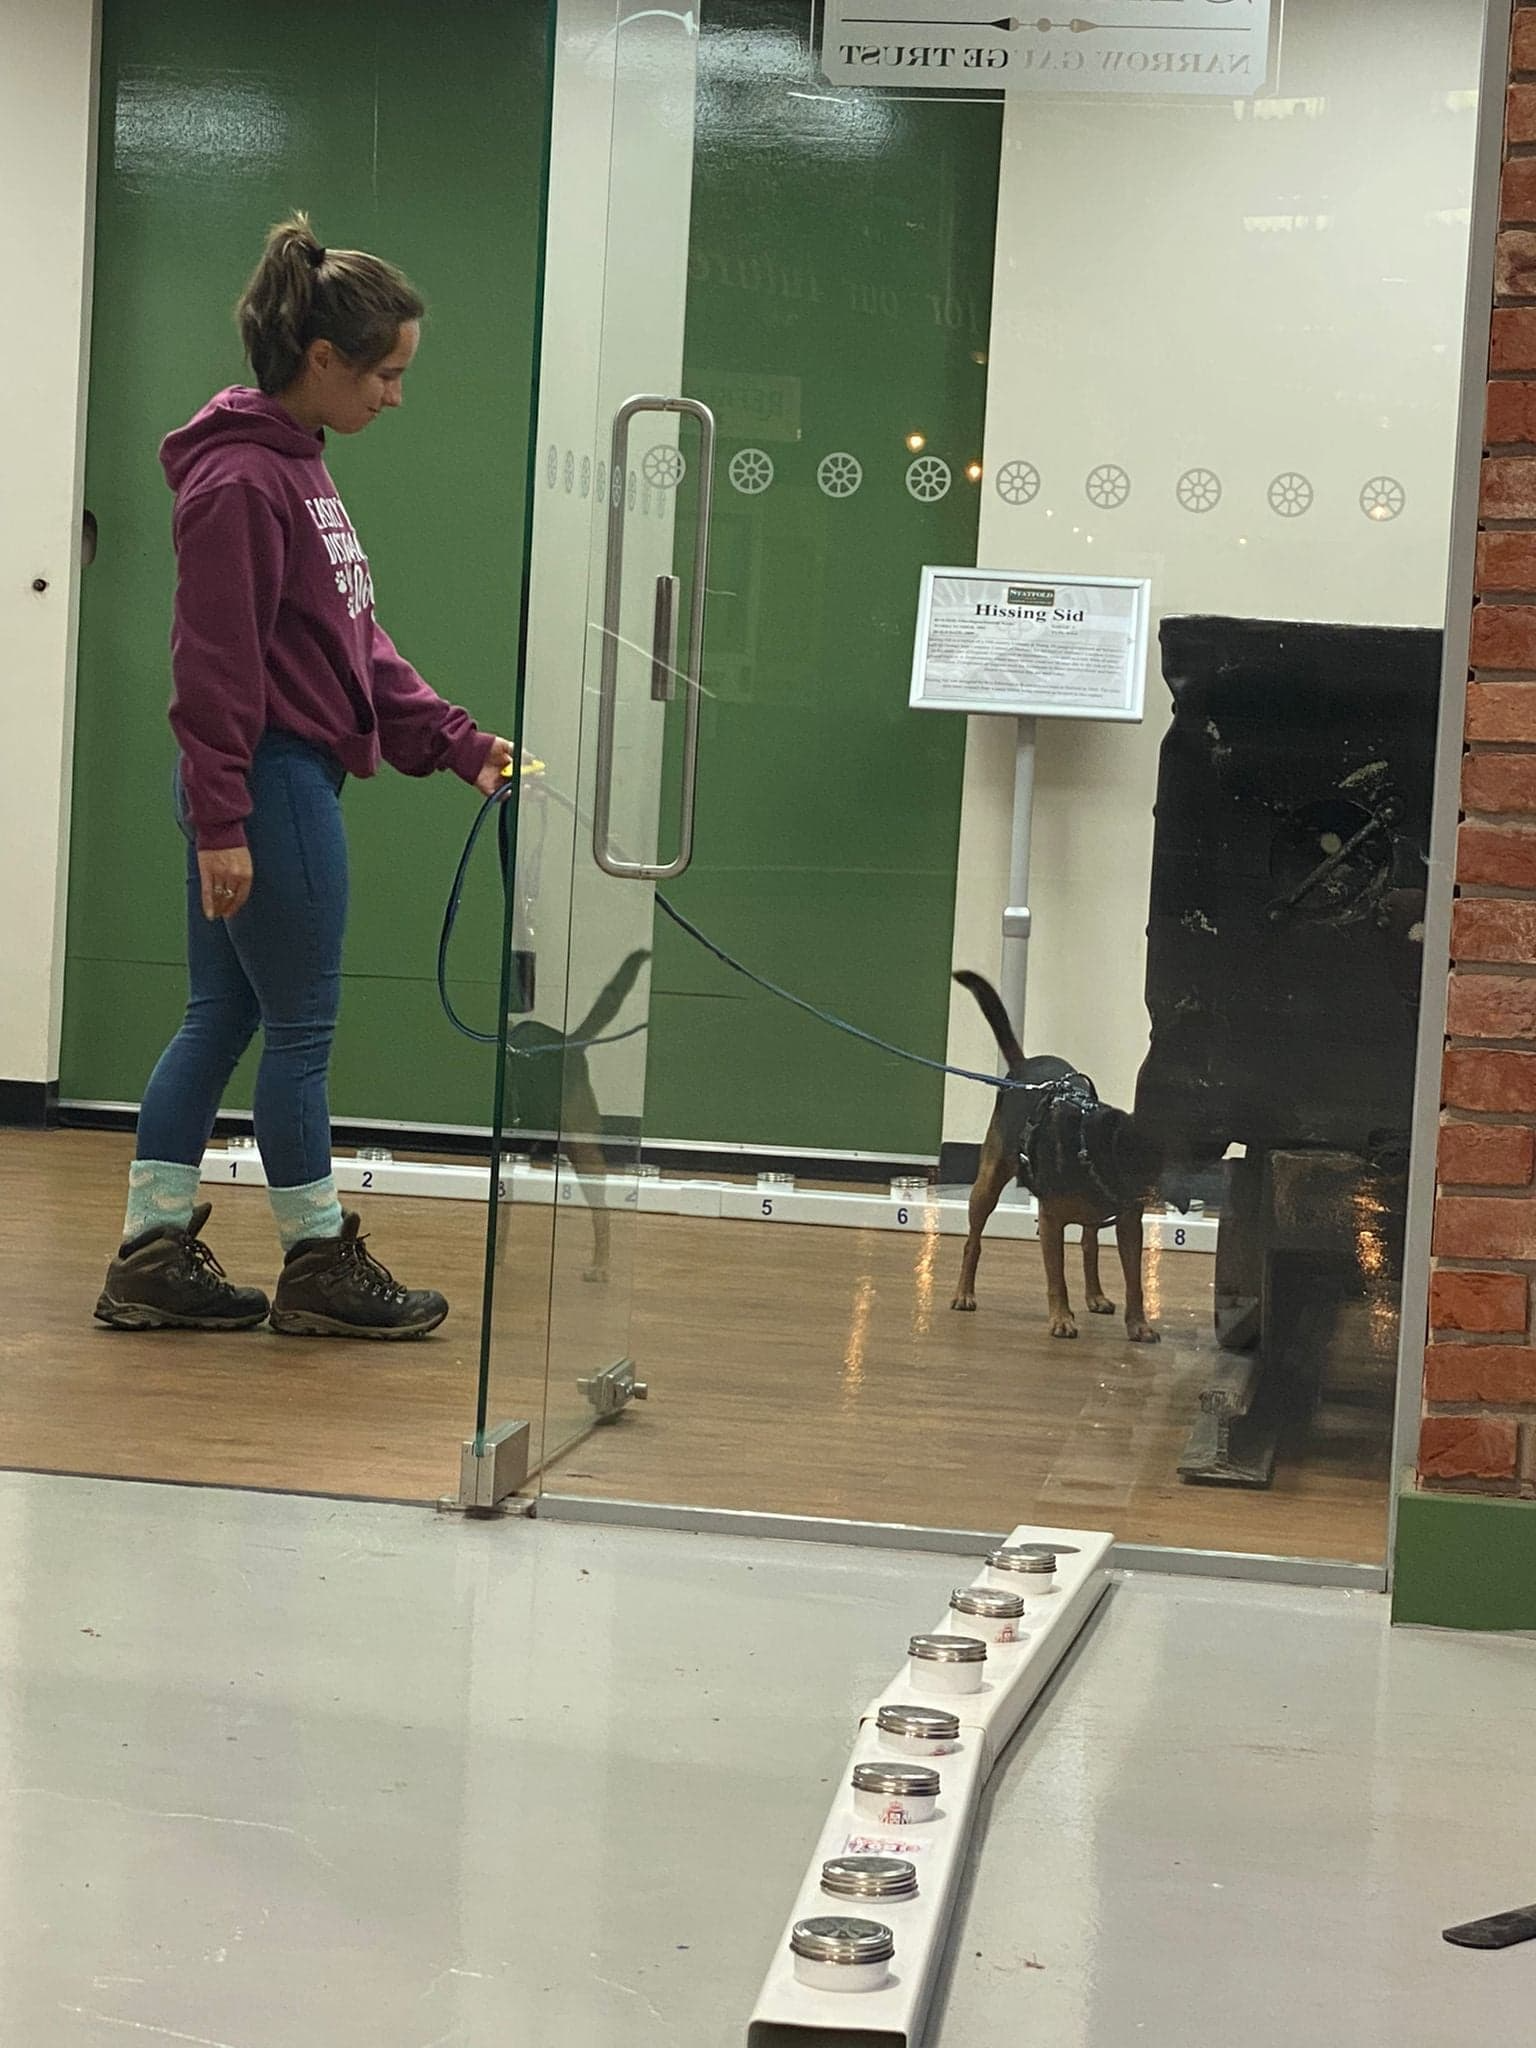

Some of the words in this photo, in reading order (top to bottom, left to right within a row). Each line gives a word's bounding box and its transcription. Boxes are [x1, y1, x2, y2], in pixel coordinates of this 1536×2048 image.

[976, 604, 1046, 622] Hissing
[1053, 609, 1084, 622] Sid
[229, 1162, 238, 1178] 1
[362, 1171, 373, 1188] 2
[762, 1199, 773, 1216] 5
[897, 1208, 908, 1225] 6
[1175, 1228, 1185, 1246] 8
